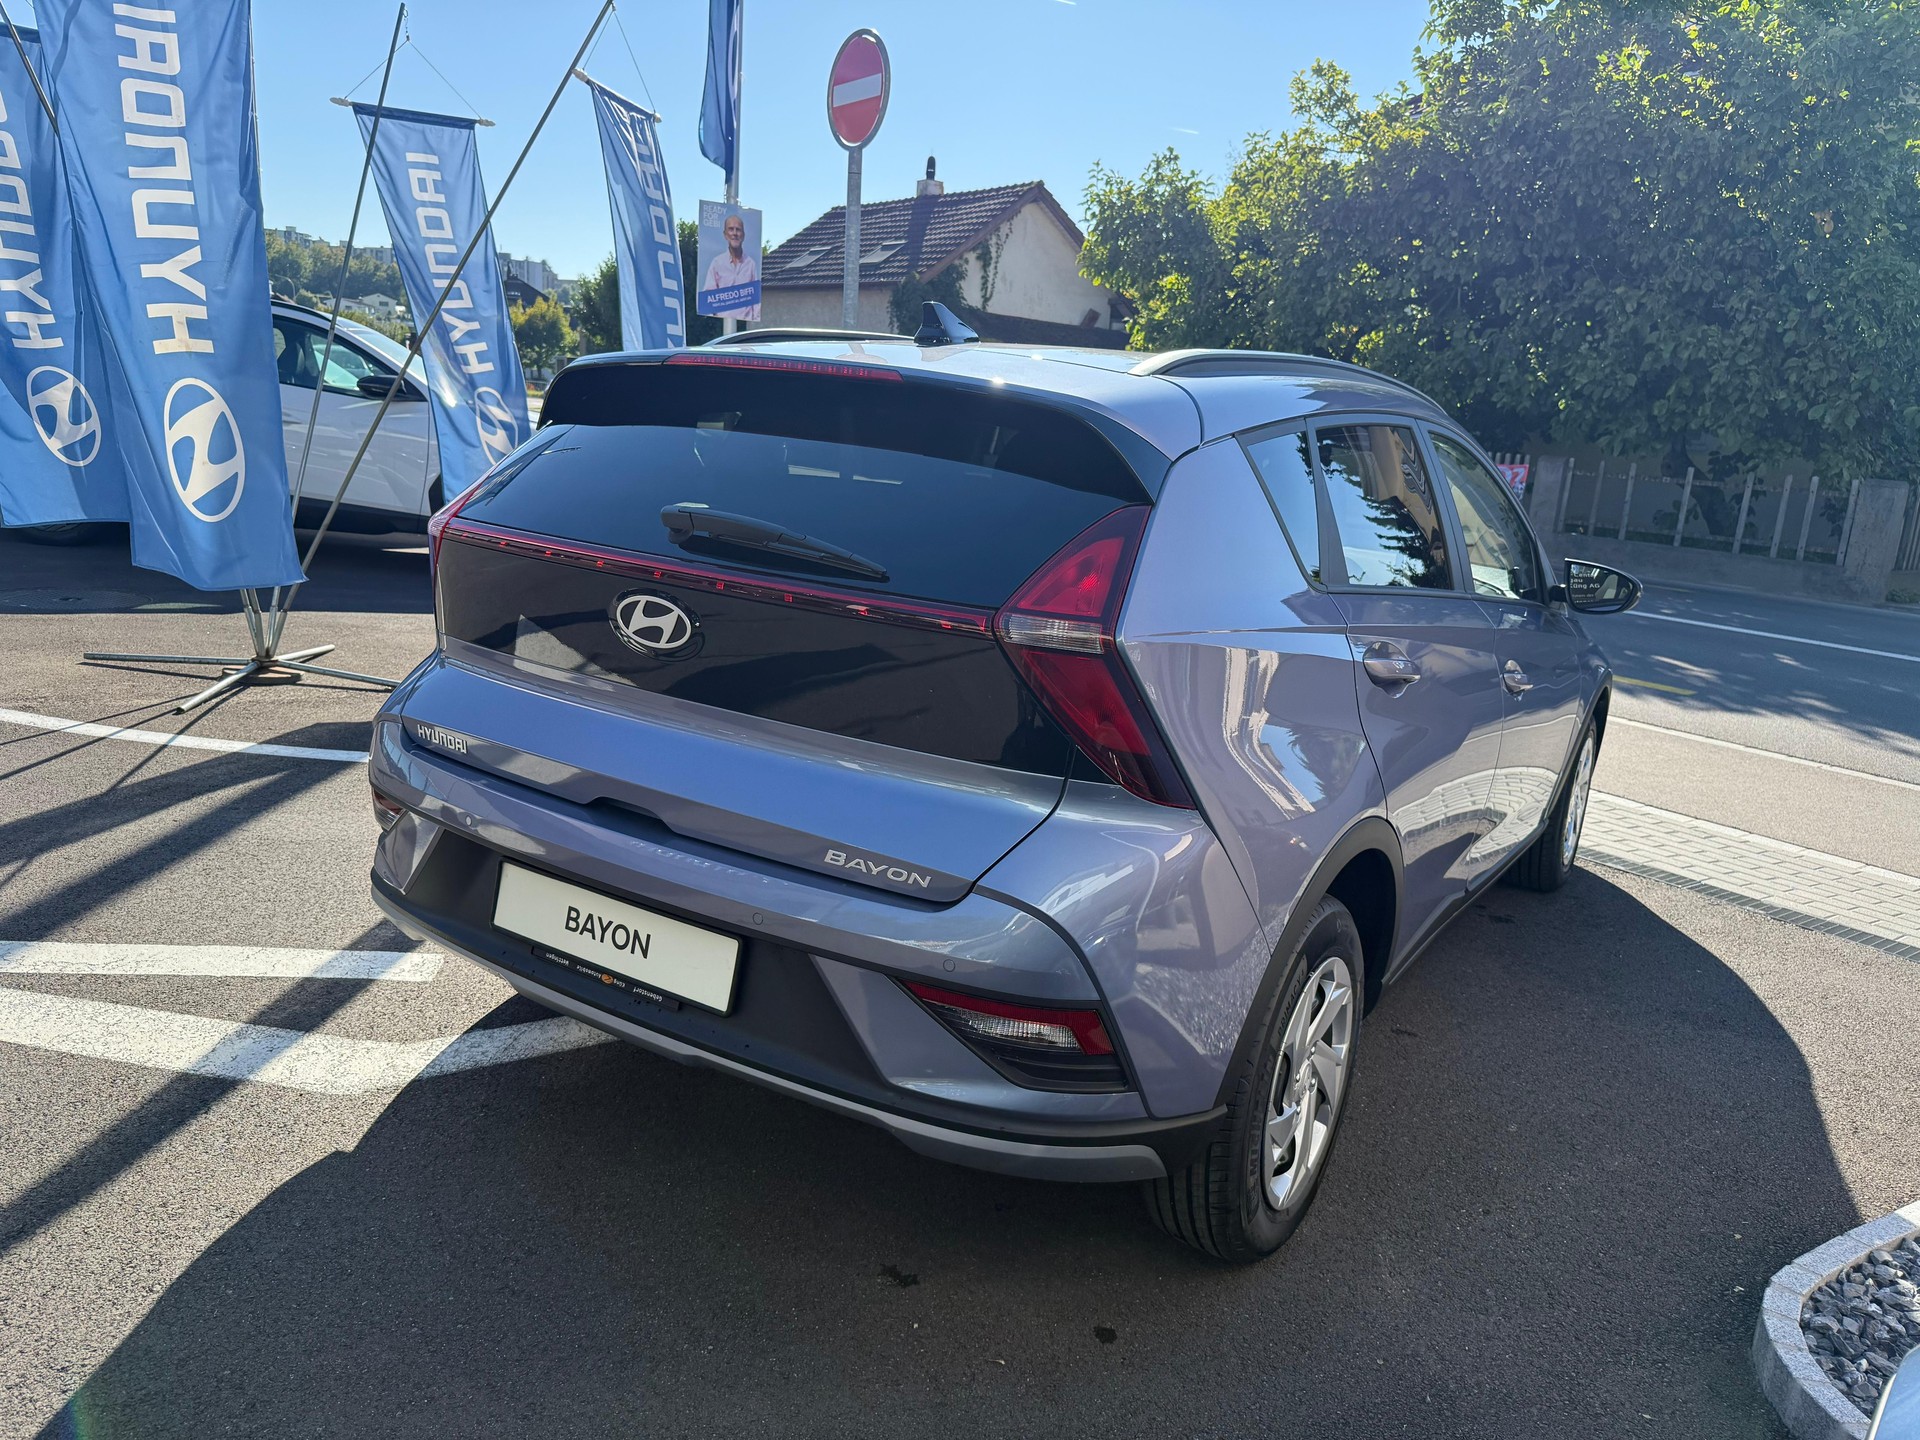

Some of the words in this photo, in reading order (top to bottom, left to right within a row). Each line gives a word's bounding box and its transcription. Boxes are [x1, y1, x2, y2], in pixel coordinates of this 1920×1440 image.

[703, 204, 728, 216] READY
[703, 211, 719, 221] FOR
[405, 152, 495, 375] HYUNDAI
[707, 290, 740, 303] ALFREDO
[740, 287, 755, 298] BIFFI
[417, 724, 467, 754] HYUNDAI
[823, 849, 932, 888] BAYON
[565, 905, 651, 959] BAYON
